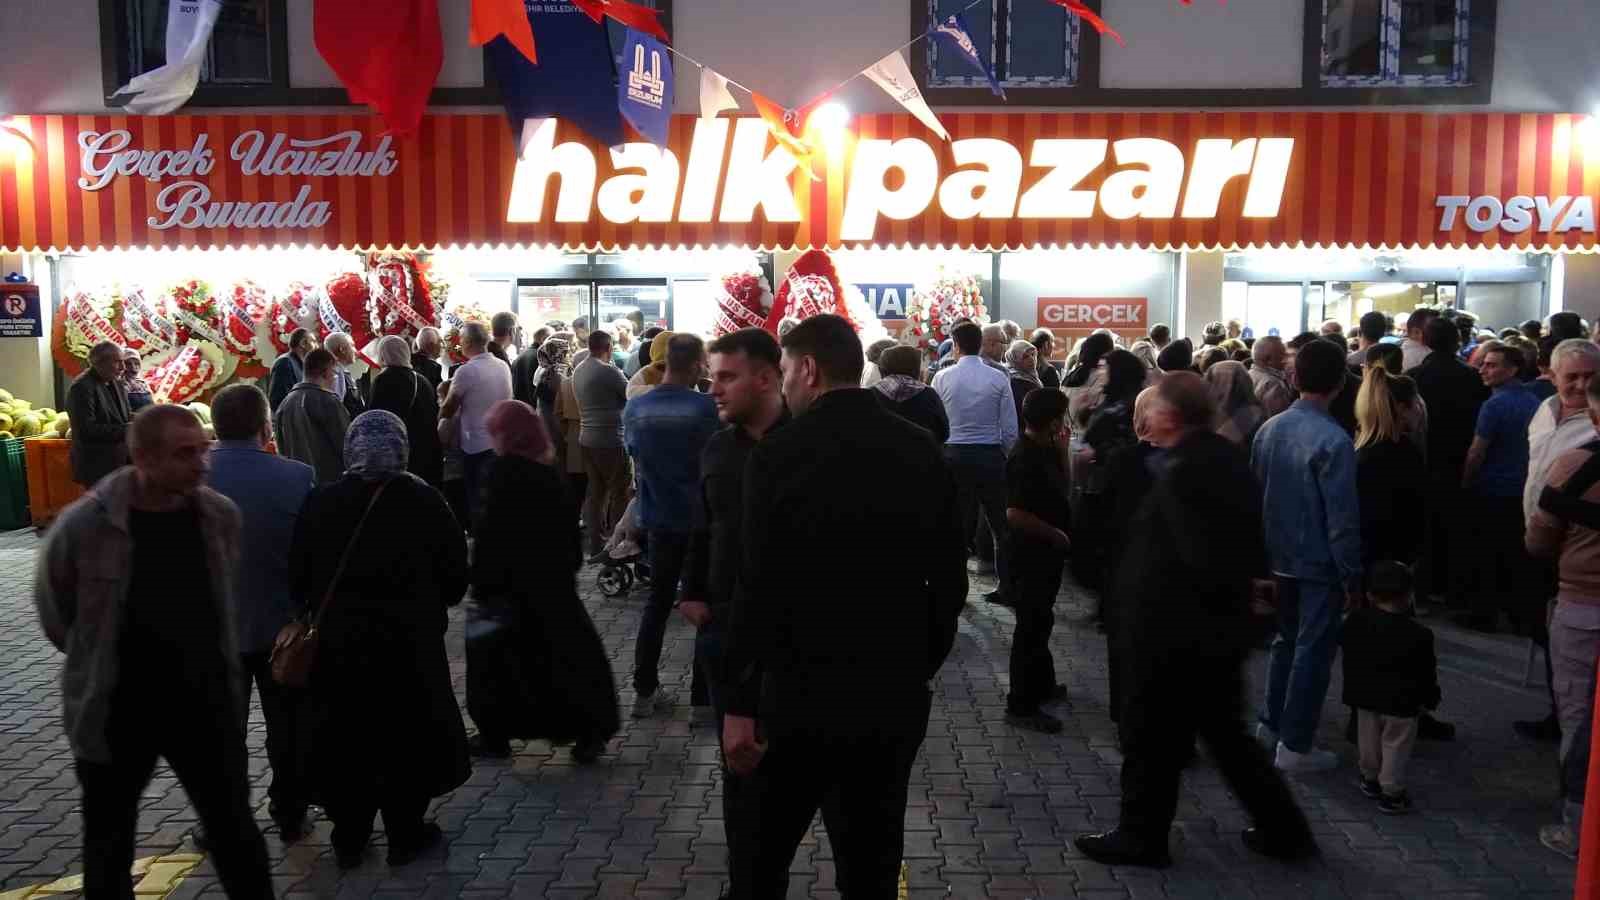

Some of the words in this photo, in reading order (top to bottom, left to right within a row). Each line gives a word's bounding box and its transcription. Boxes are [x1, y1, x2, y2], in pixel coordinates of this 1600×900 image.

[77, 129, 215, 191] Gerçek
[230, 130, 399, 178] Ucuzluk
[506, 117, 801, 224] halk
[840, 138, 1295, 241] pazarı
[147, 180, 332, 230] Burada
[1435, 195, 1596, 234] TOSYA
[1043, 304, 1142, 325] GERÇEK
